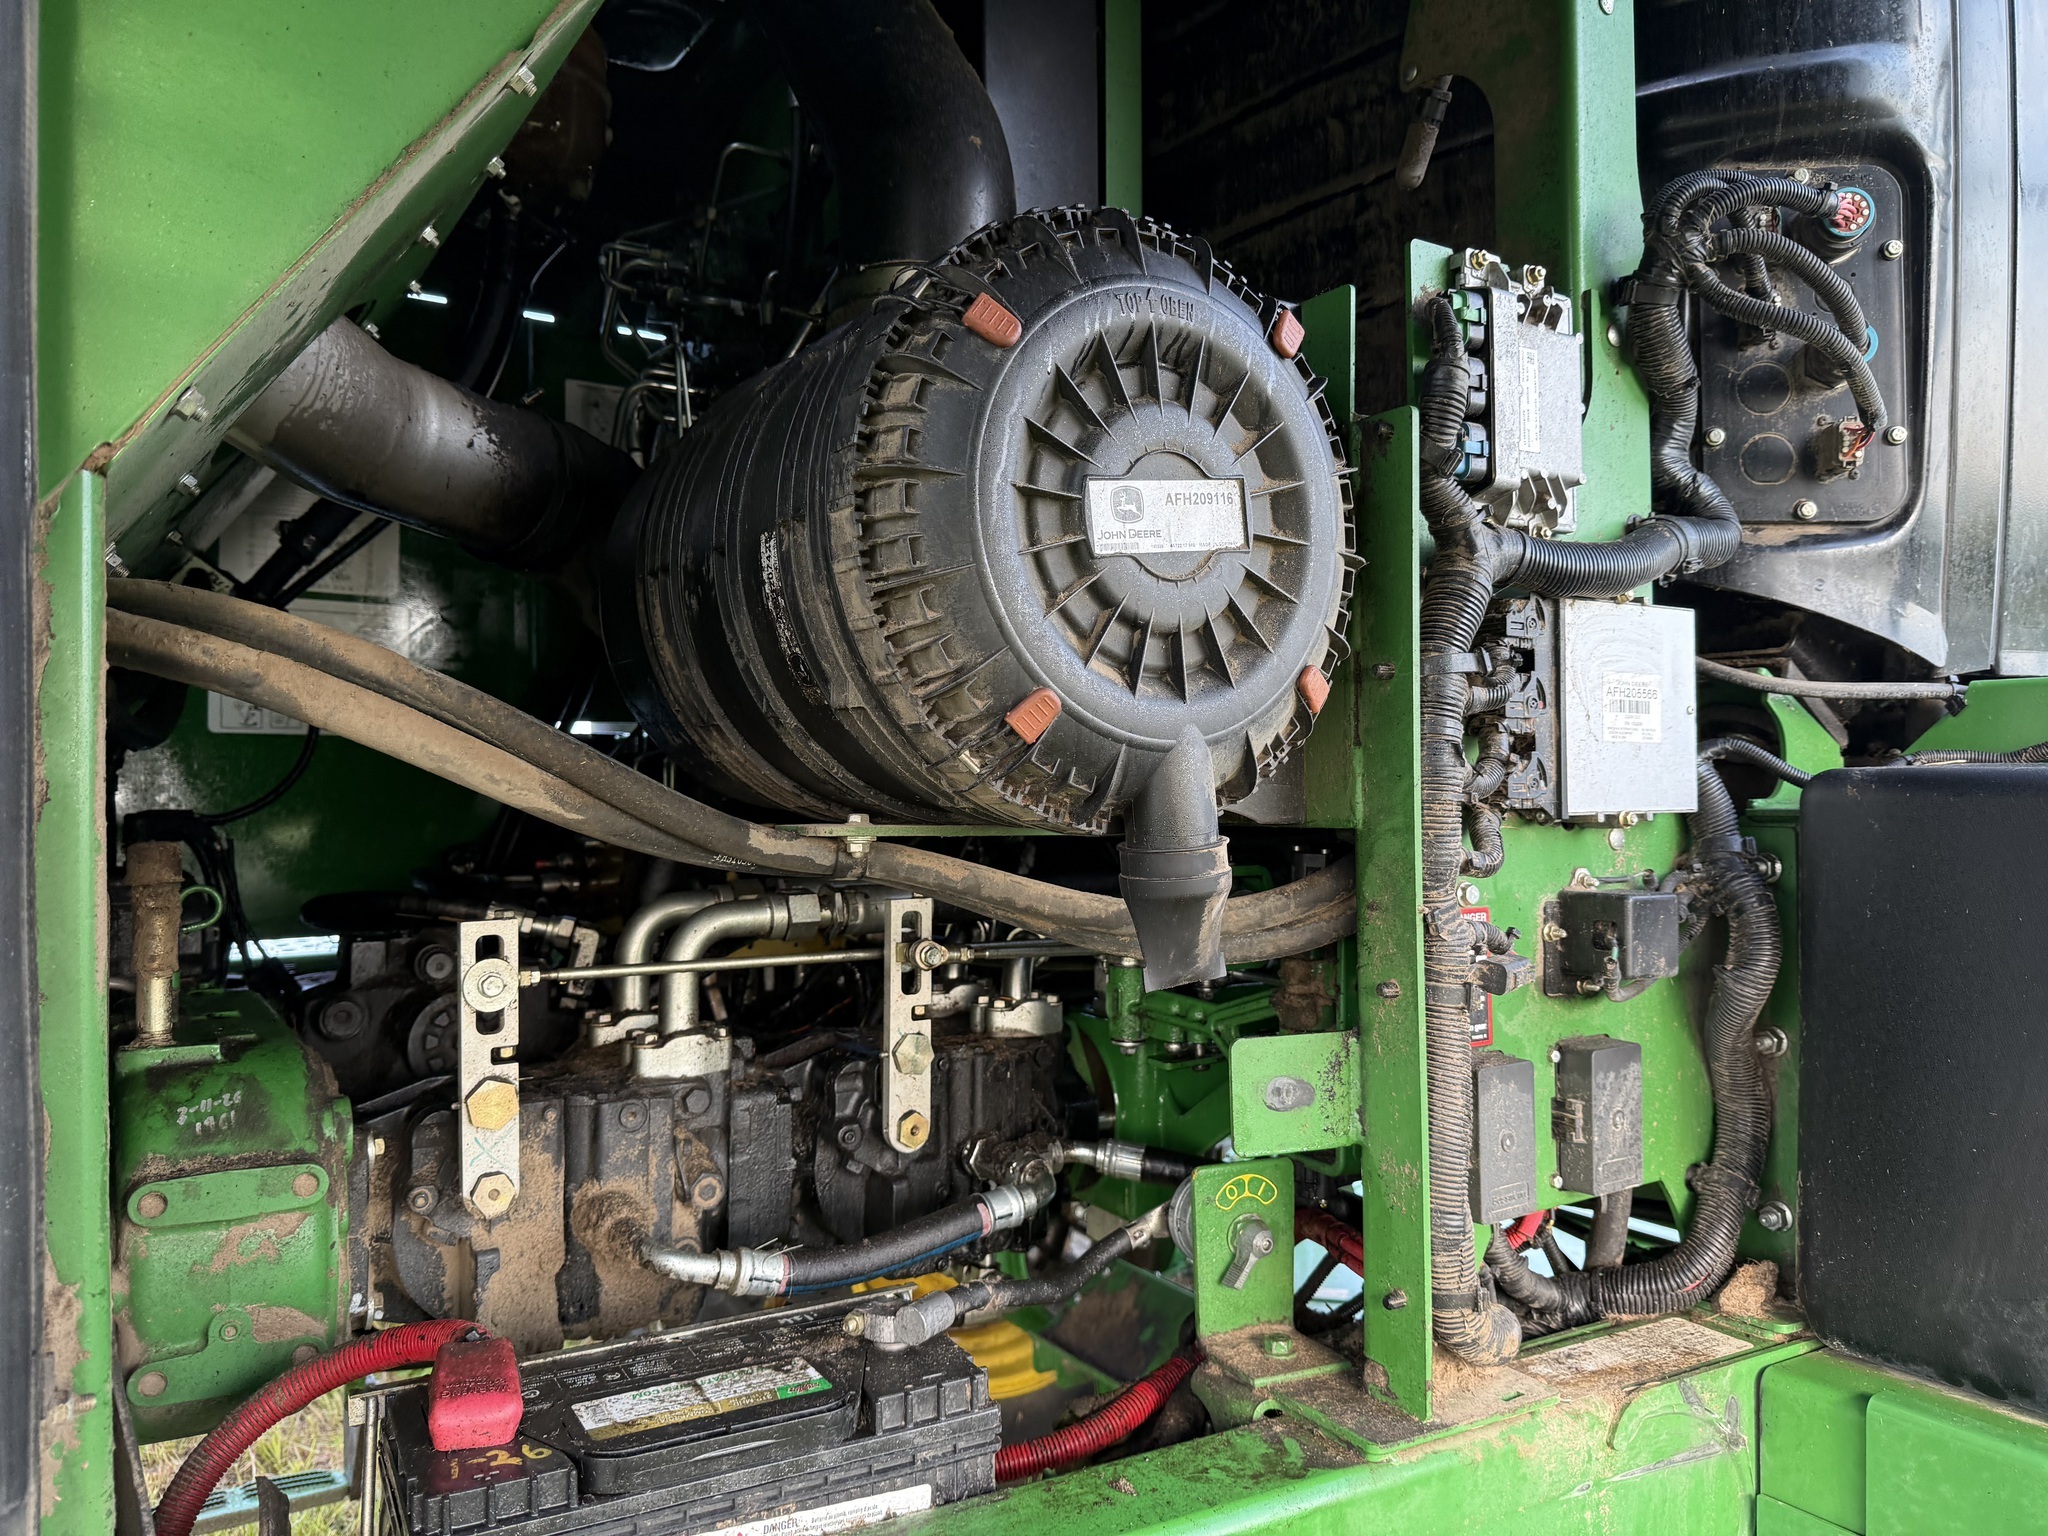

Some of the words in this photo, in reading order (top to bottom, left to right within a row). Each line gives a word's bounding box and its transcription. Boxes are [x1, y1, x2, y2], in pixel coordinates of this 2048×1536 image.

[1116, 292, 1142, 315] TOP
[1165, 492, 1233, 506] AFH209116
[1097, 529, 1127, 540] JOHN
[1128, 528, 1162, 539] DEERE
[1606, 686, 1658, 700] AFH205566
[763, 1518, 798, 1535] DANGER
